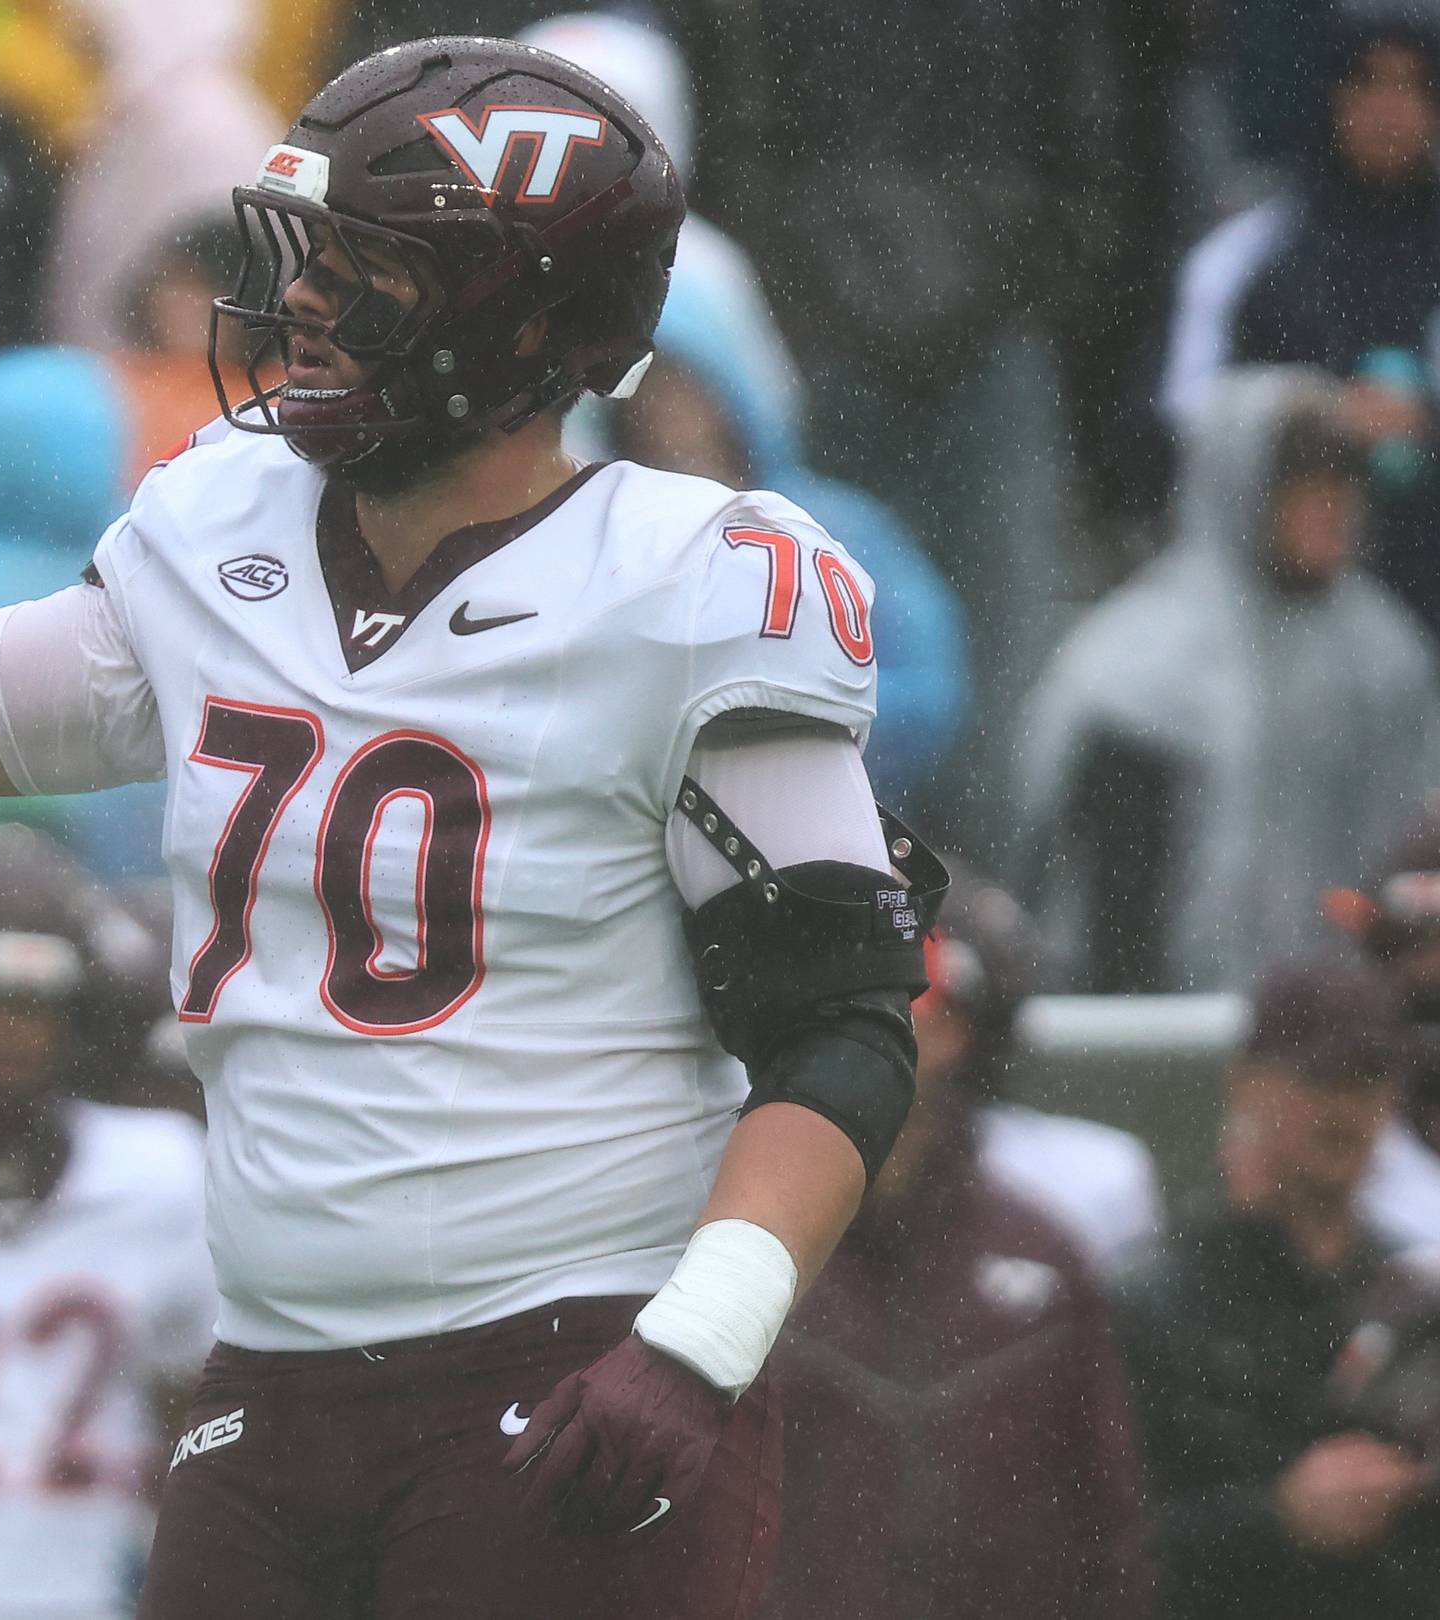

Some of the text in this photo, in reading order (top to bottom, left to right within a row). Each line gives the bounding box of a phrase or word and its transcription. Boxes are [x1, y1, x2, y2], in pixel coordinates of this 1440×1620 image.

[417, 104, 607, 208] VT
[227, 564, 284, 586] ACC
[723, 526, 874, 667] 70
[351, 609, 406, 647] VT
[179, 694, 492, 1036] 70
[166, 1407, 245, 1478] OKIES
